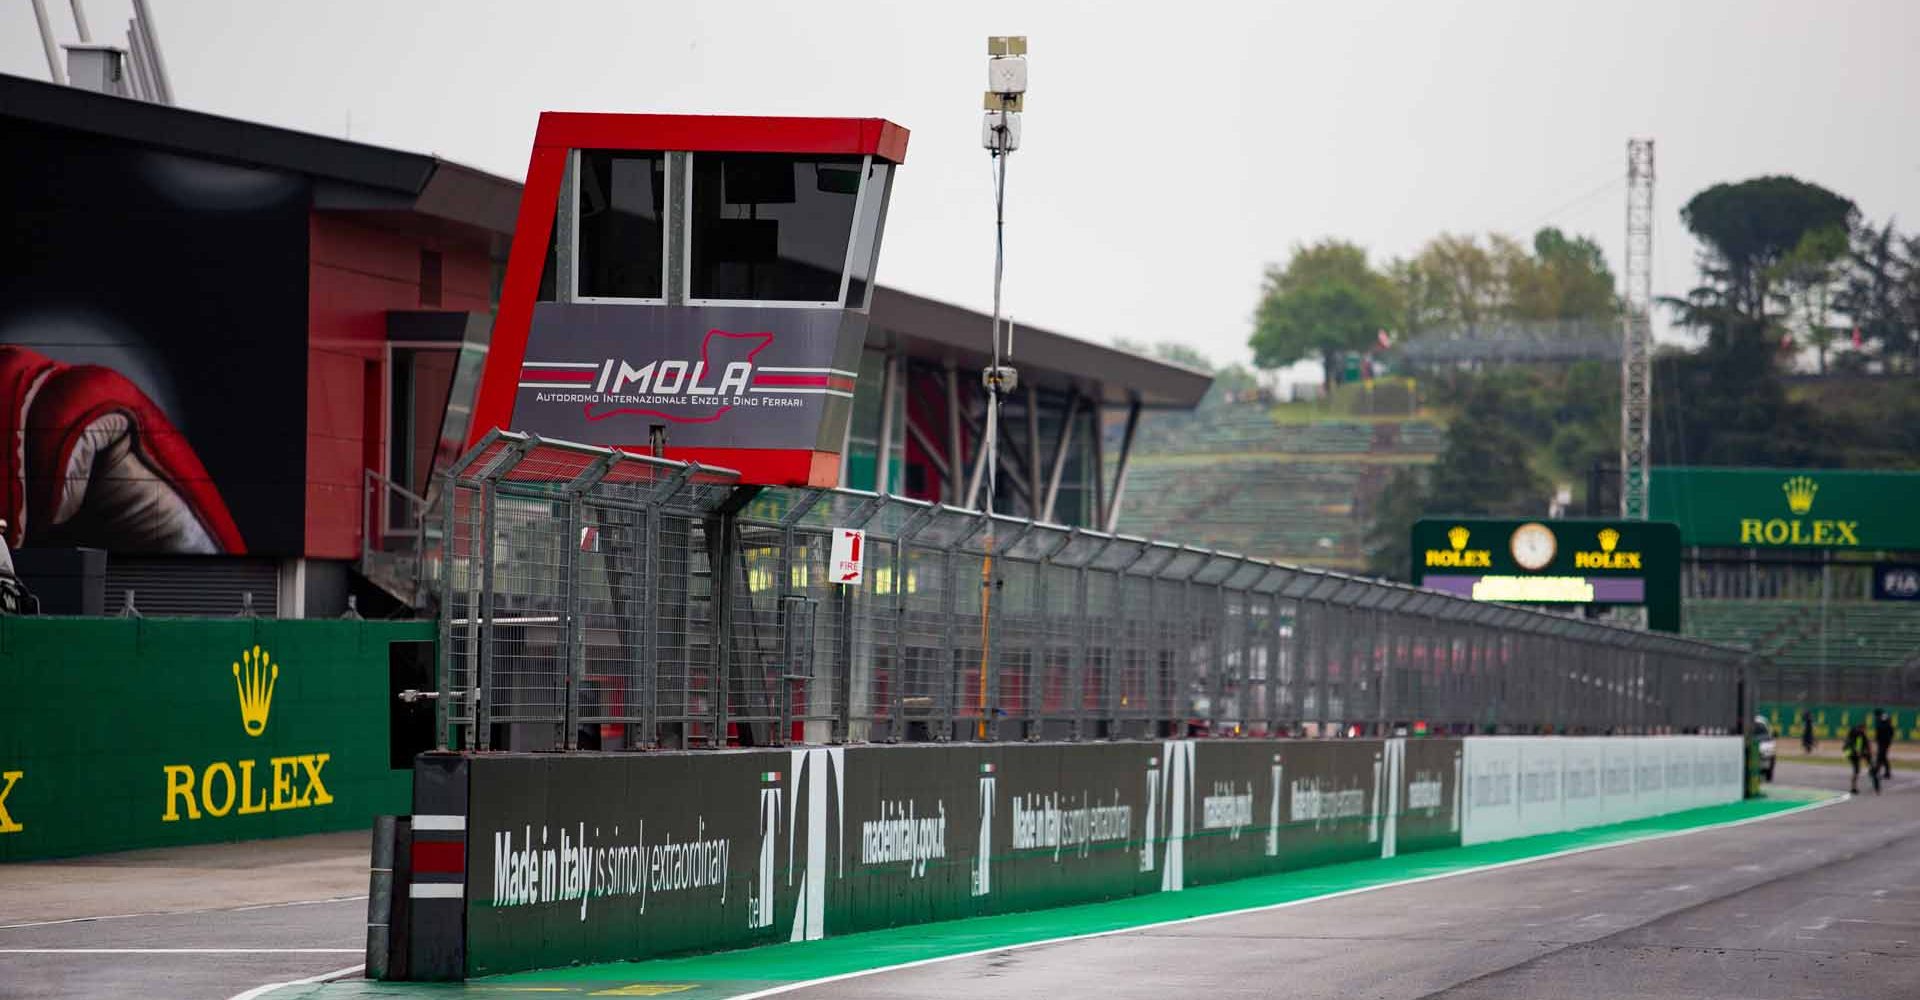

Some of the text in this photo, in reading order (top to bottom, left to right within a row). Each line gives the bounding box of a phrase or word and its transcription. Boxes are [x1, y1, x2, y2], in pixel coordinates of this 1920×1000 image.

[596, 359, 752, 396] IMOLA
[1740, 518, 1860, 546] ROLEX
[840, 561, 859, 571] FIRE
[1425, 549, 1492, 567] ROLEX
[1574, 551, 1642, 569] ROLEX
[1884, 571, 1919, 594] FIA
[162, 753, 333, 821] ROLEX
[493, 815, 730, 921] Made in Italy is simply extraordinary
